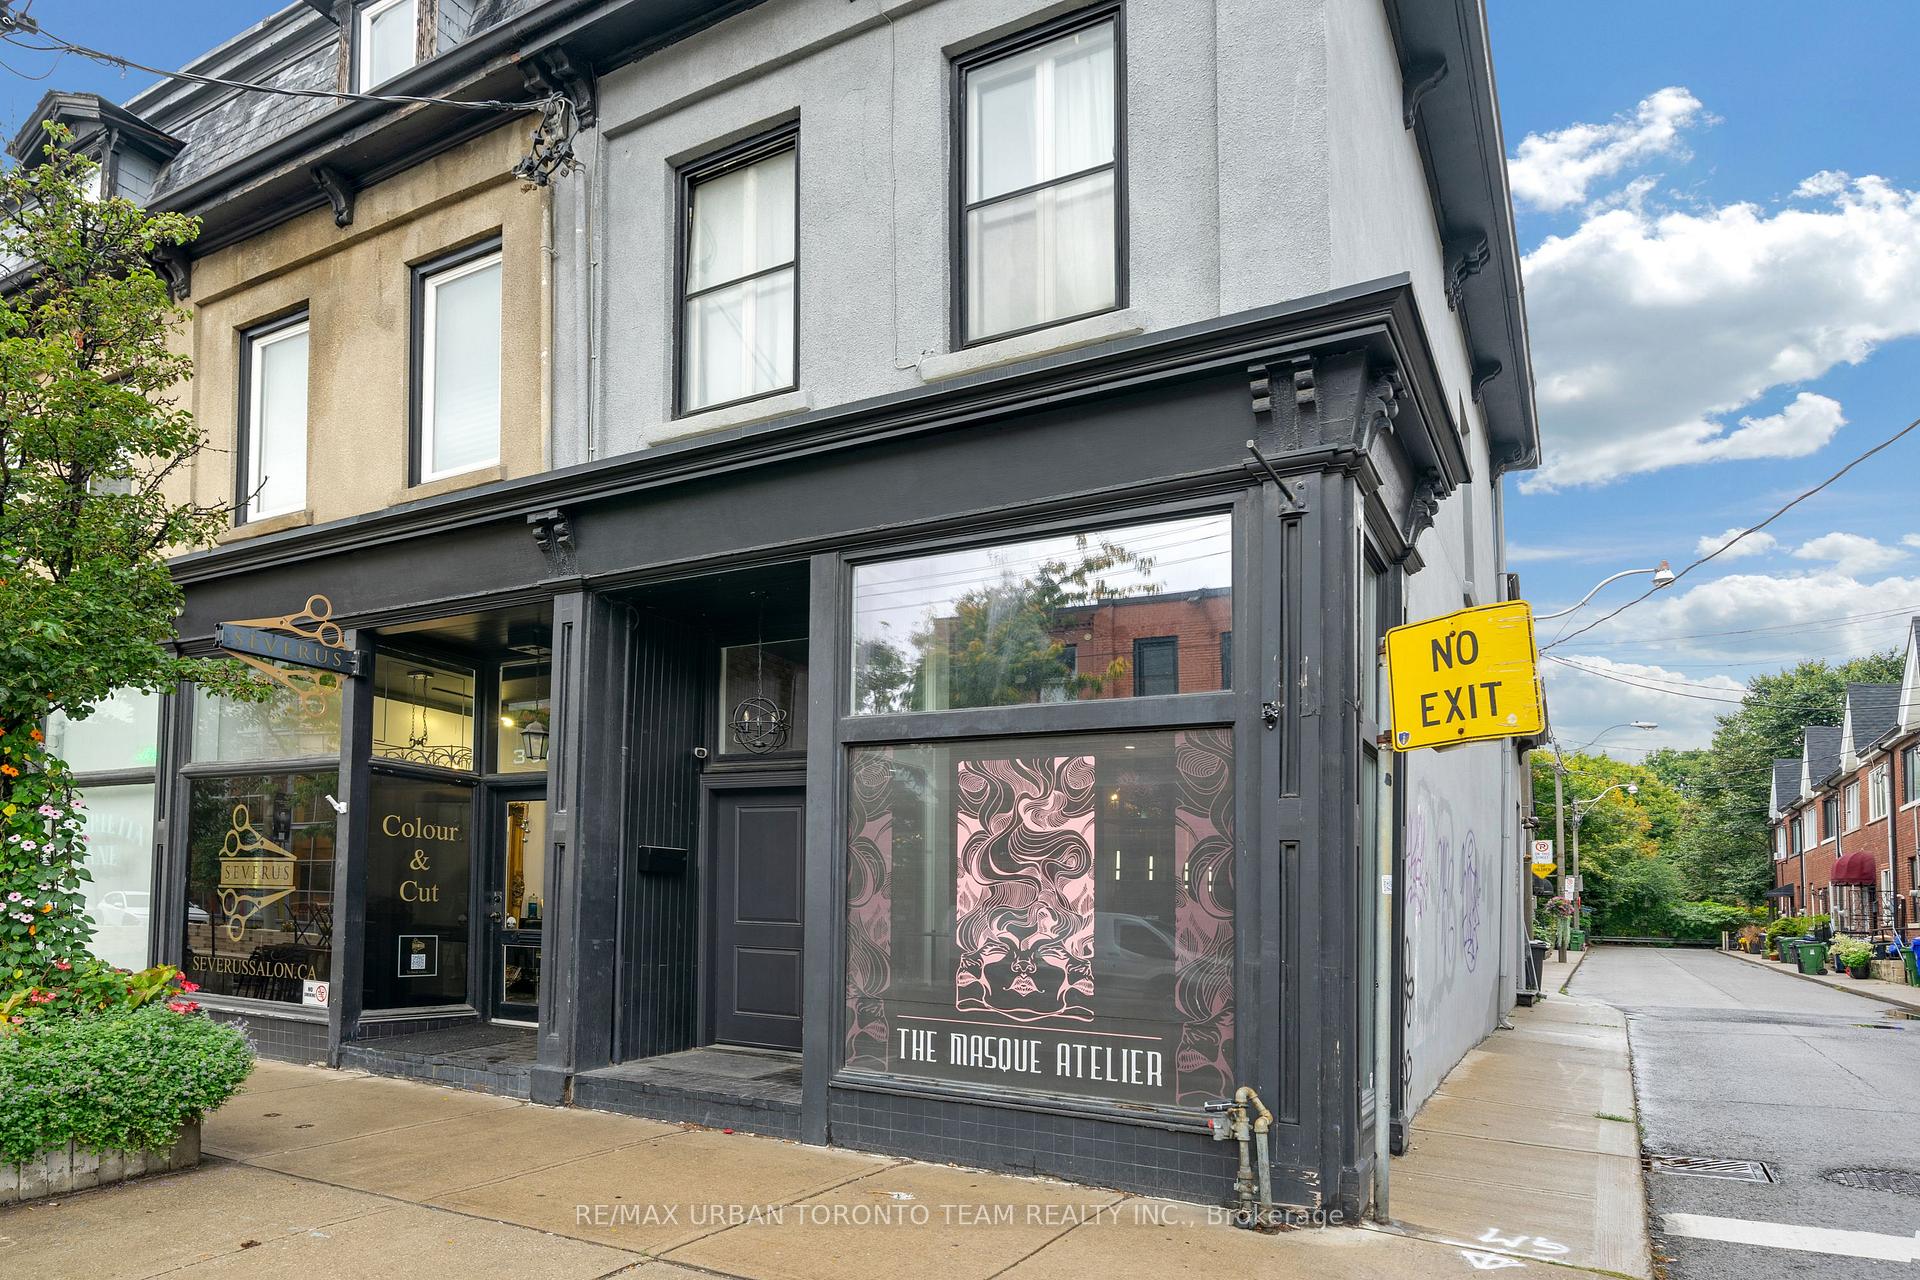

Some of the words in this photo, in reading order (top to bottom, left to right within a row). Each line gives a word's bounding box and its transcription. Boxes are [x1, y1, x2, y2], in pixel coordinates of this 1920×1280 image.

[233, 631, 342, 667] SEVERUS
[1431, 630, 1479, 672] NO
[1420, 681, 1502, 728] EXIT
[382, 814, 459, 841] Colour
[224, 864, 290, 881] SEVERUS
[409, 849, 430, 870] &
[399, 880, 440, 902] Cut
[192, 955, 318, 981] SEVERUSSALON.CA
[897, 1028, 937, 1063] THE
[950, 1033, 1042, 1074] MASQUE
[1056, 1043, 1162, 1087] ATELIER
